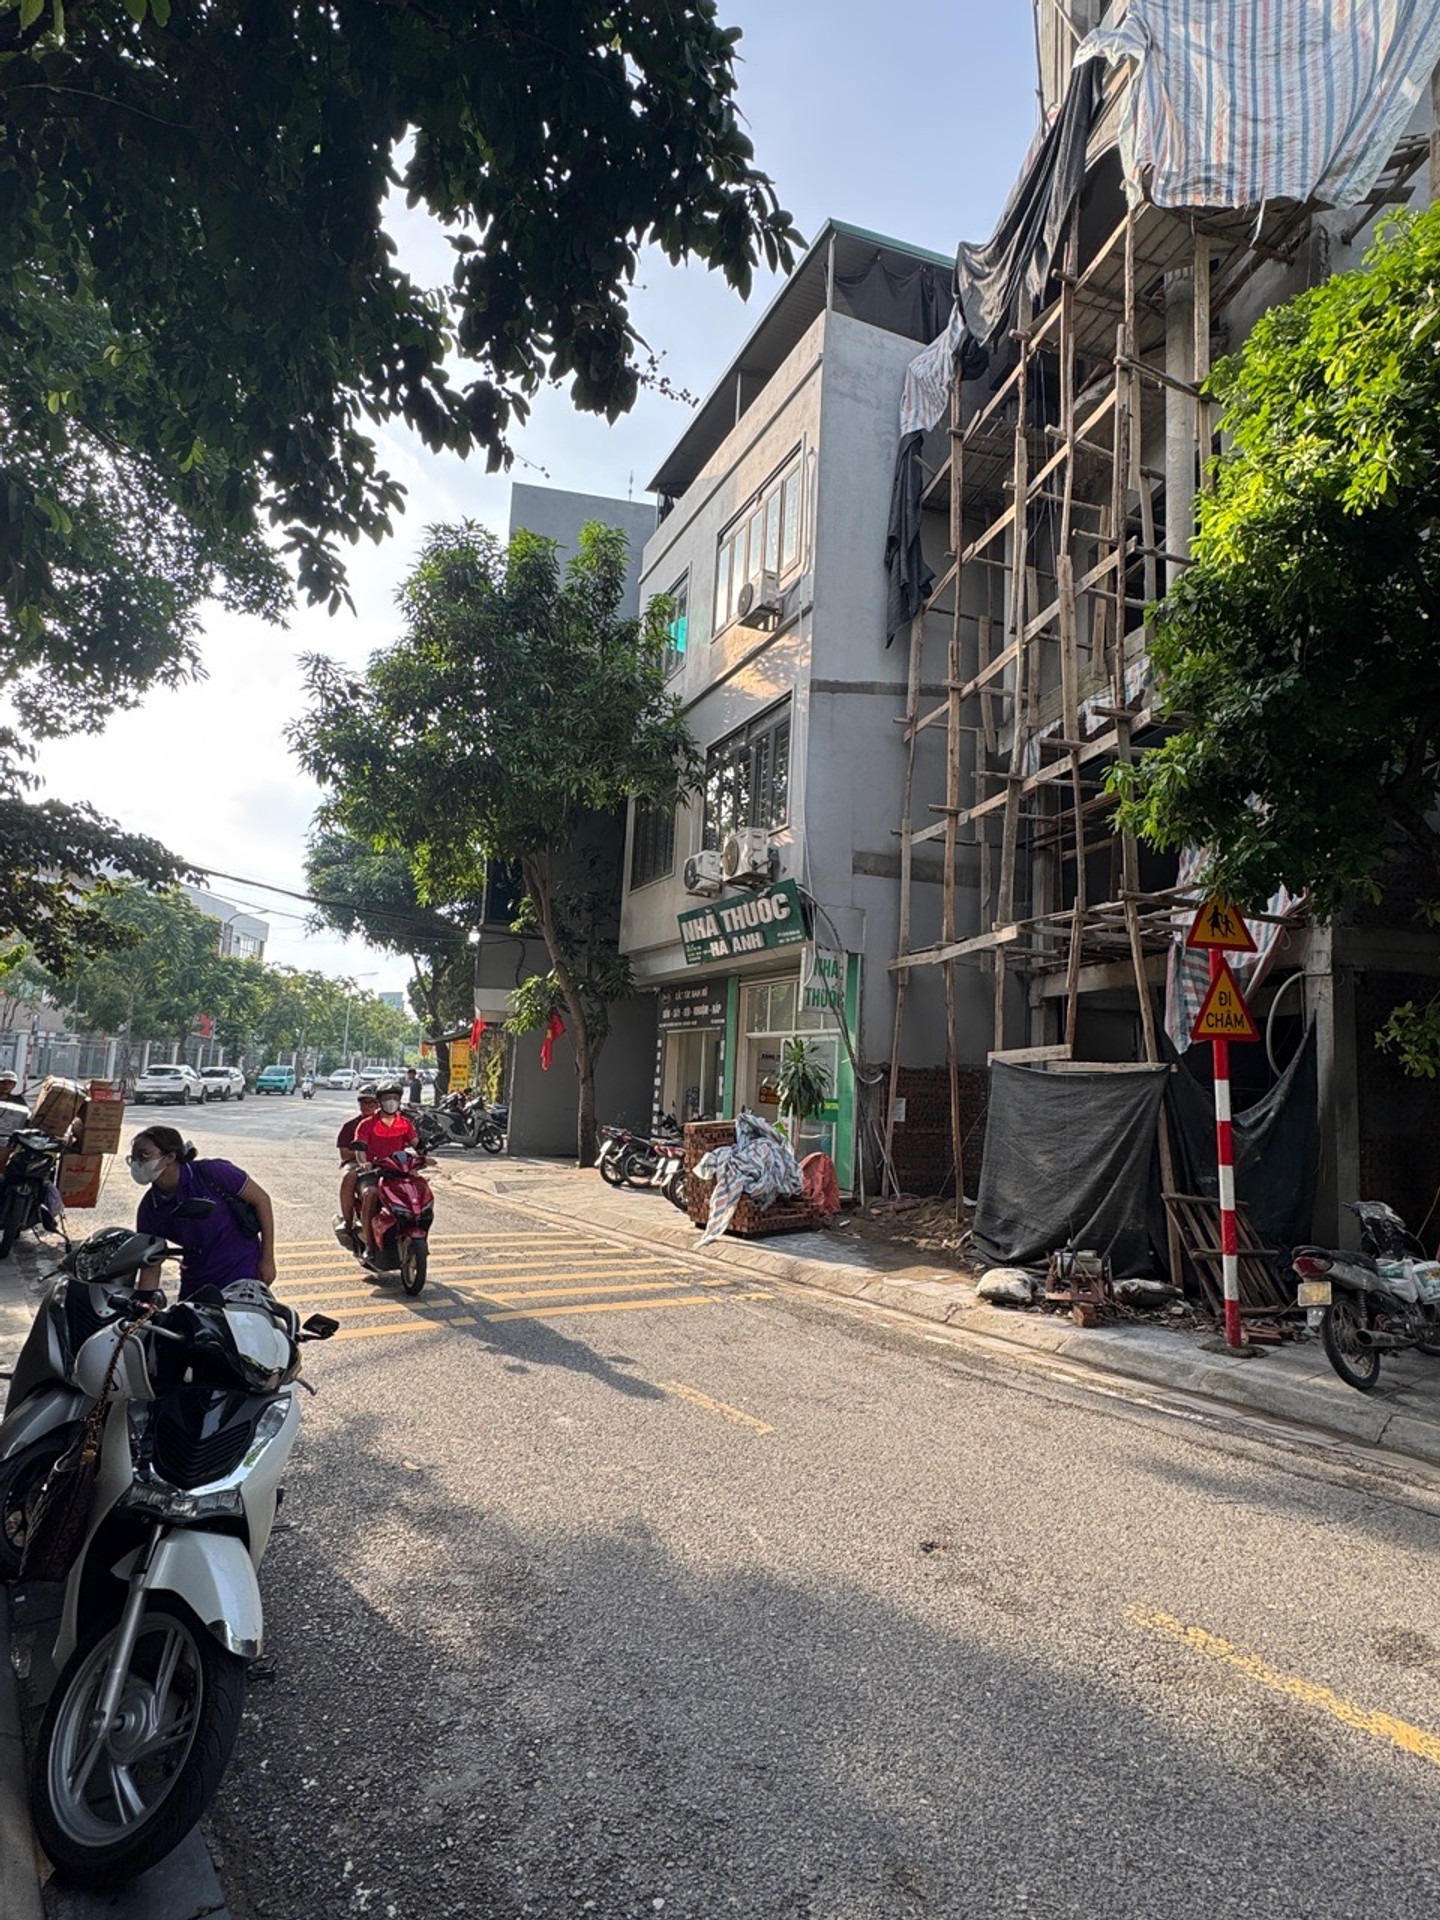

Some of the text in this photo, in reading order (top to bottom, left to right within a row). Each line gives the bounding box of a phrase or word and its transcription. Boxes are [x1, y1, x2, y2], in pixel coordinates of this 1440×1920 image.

[681, 887, 791, 943] NHÀ THUỐC
[710, 937, 729, 957] HÀ
[732, 932, 765, 952] ANH
[813, 956, 838, 978] NHÀ
[1218, 991, 1232, 1006] ĐI
[1206, 1010, 1245, 1031] CHẬM
